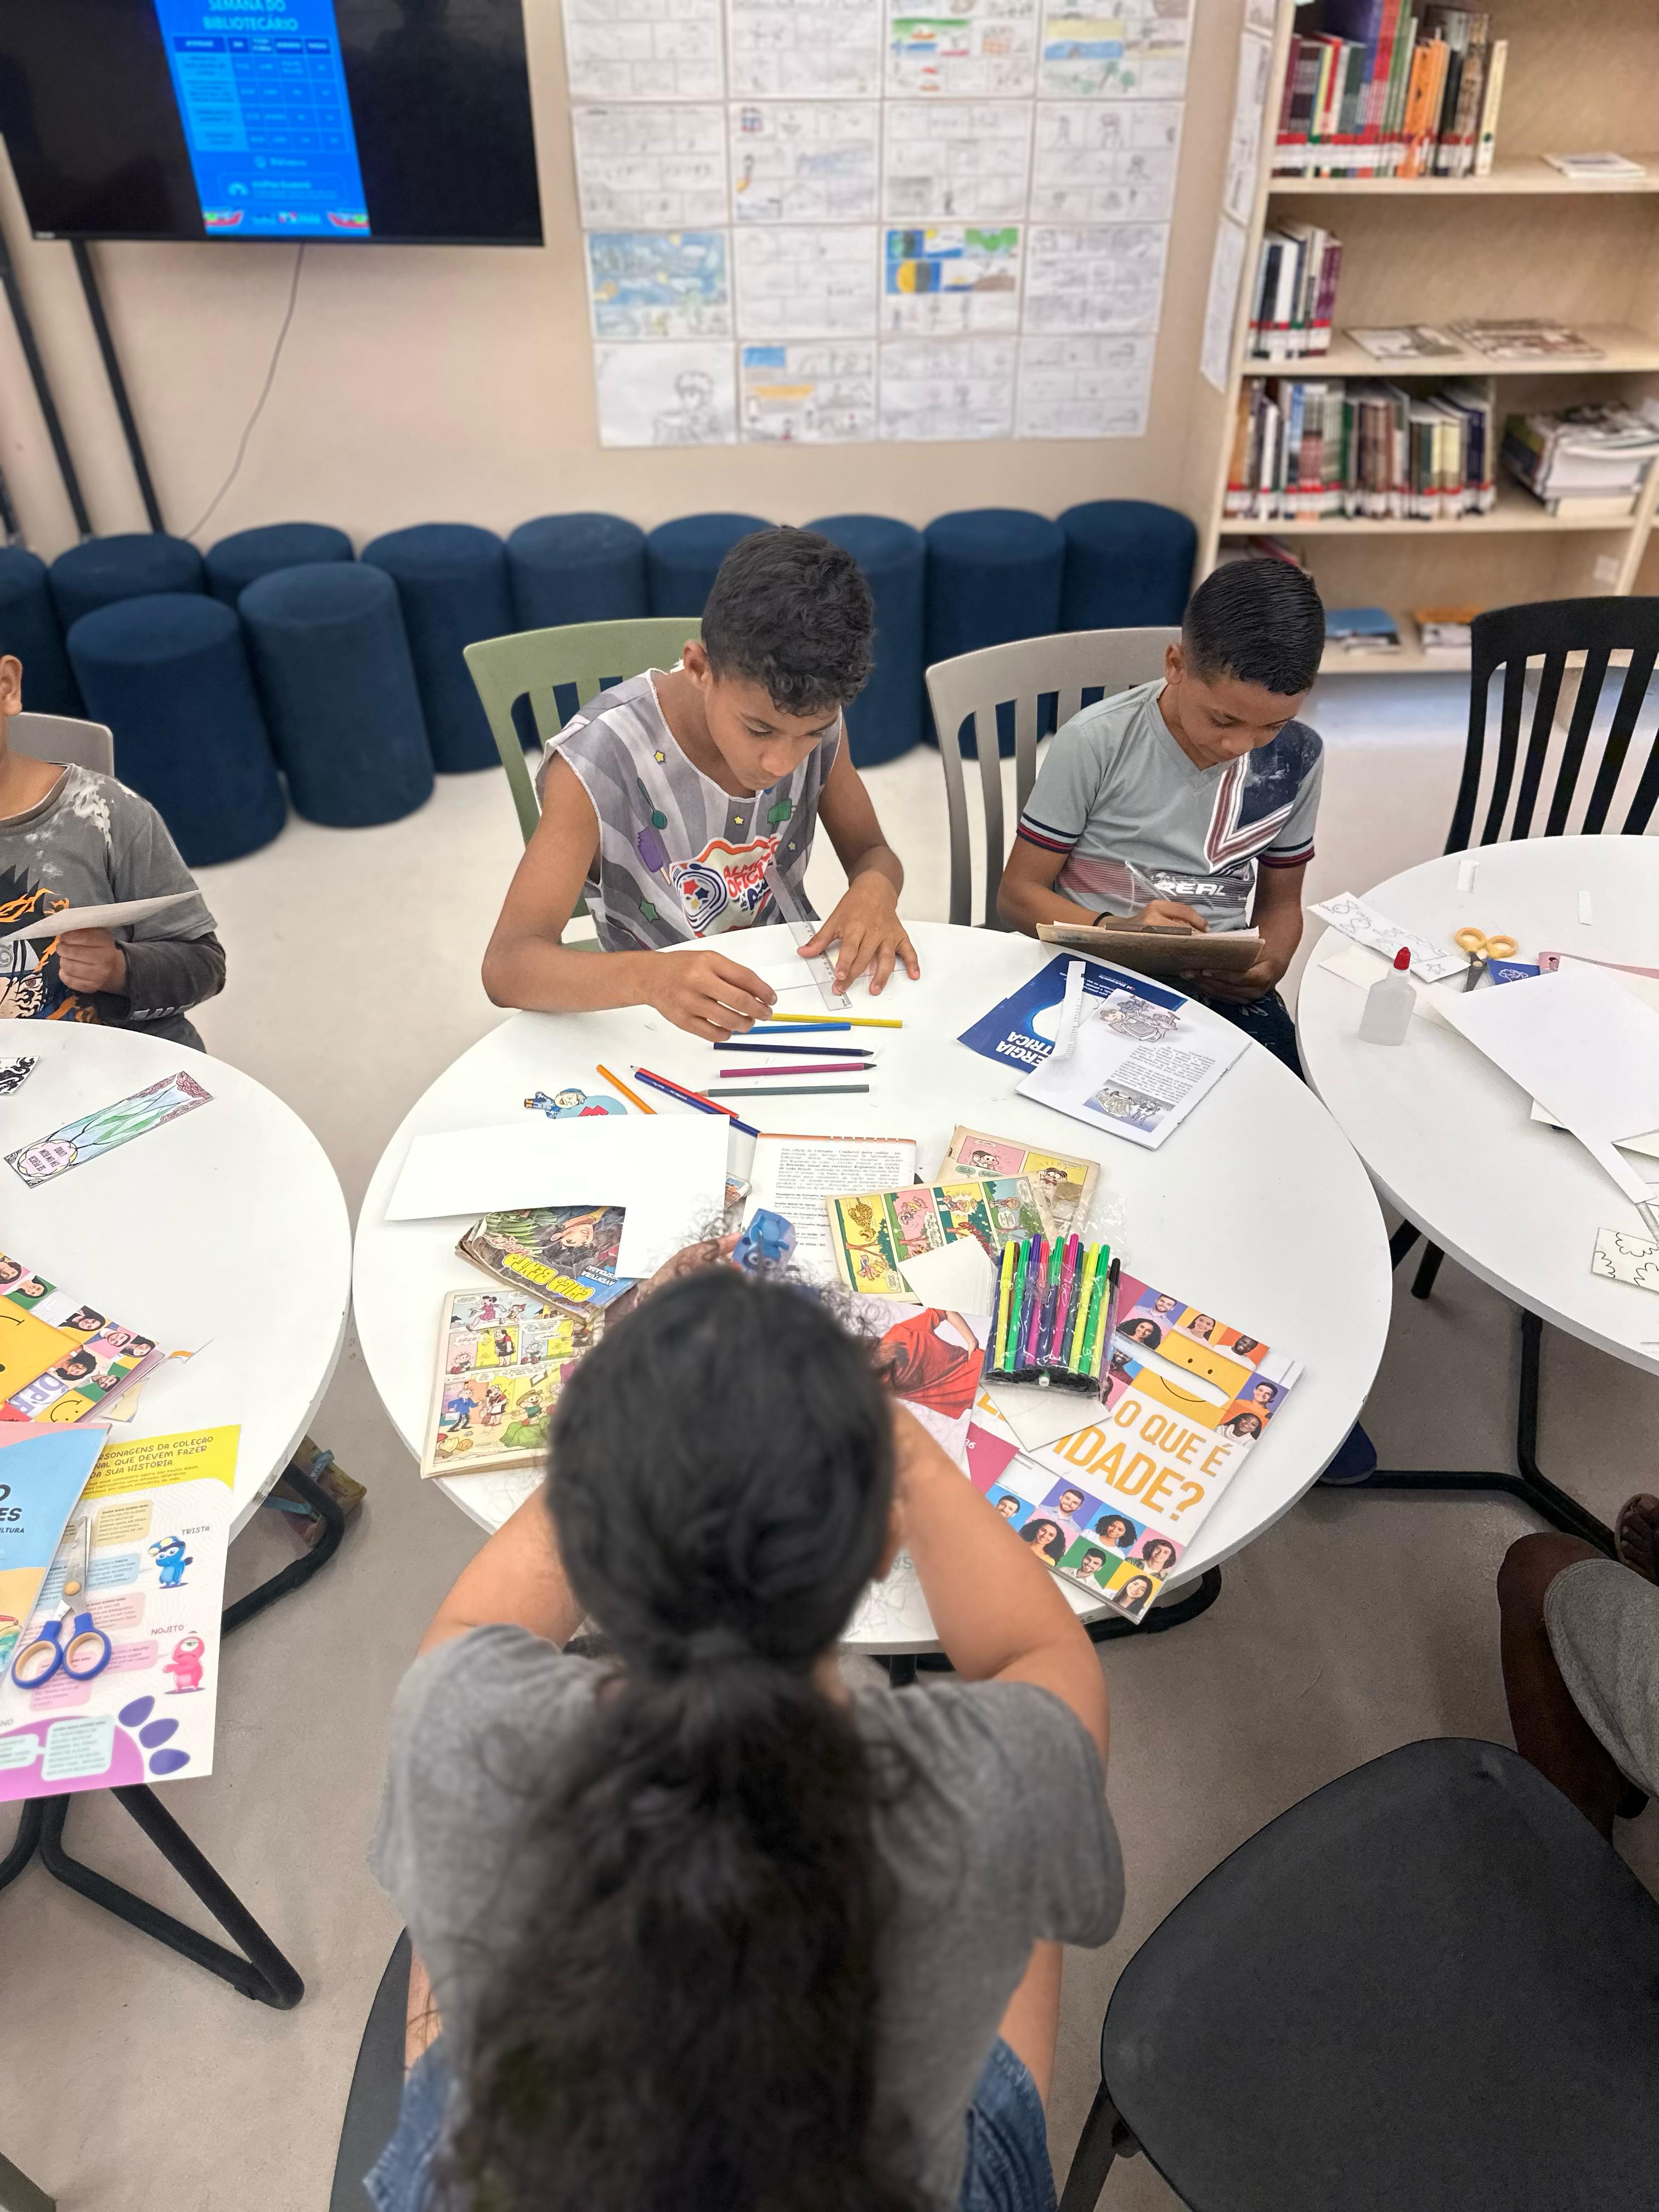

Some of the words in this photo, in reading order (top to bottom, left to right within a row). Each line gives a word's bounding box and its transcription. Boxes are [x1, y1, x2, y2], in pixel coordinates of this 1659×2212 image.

[202, 15, 298, 31] BIBLIOTECÁRIO
[1154, 881, 1226, 896] REAL
[1006, 1031, 1052, 1056] TRICA
[995, 1040, 1048, 1066] ERGIA
[501, 1253, 557, 1284] BENTO
[580, 1269, 615, 1285] AVENTURA
[585, 1264, 619, 1279] ESPERADA!
[545, 1275, 595, 1302] CHICO
[1114, 1400, 1139, 1427] O
[1140, 1413, 1206, 1464] QUE
[1200, 1443, 1232, 1477] É
[98, 1446, 154, 1460] RSONAGENS
[173, 1436, 213, 1448] COLEÇÃO
[115, 1457, 134, 1466] QUE
[139, 1451, 173, 1462] DEVEM
[177, 1445, 207, 1456] FAZER
[105, 1467, 124, 1476] SUA
[181, 1525, 210, 1537] TRISTA
[151, 1624, 184, 1635] NOJITO
